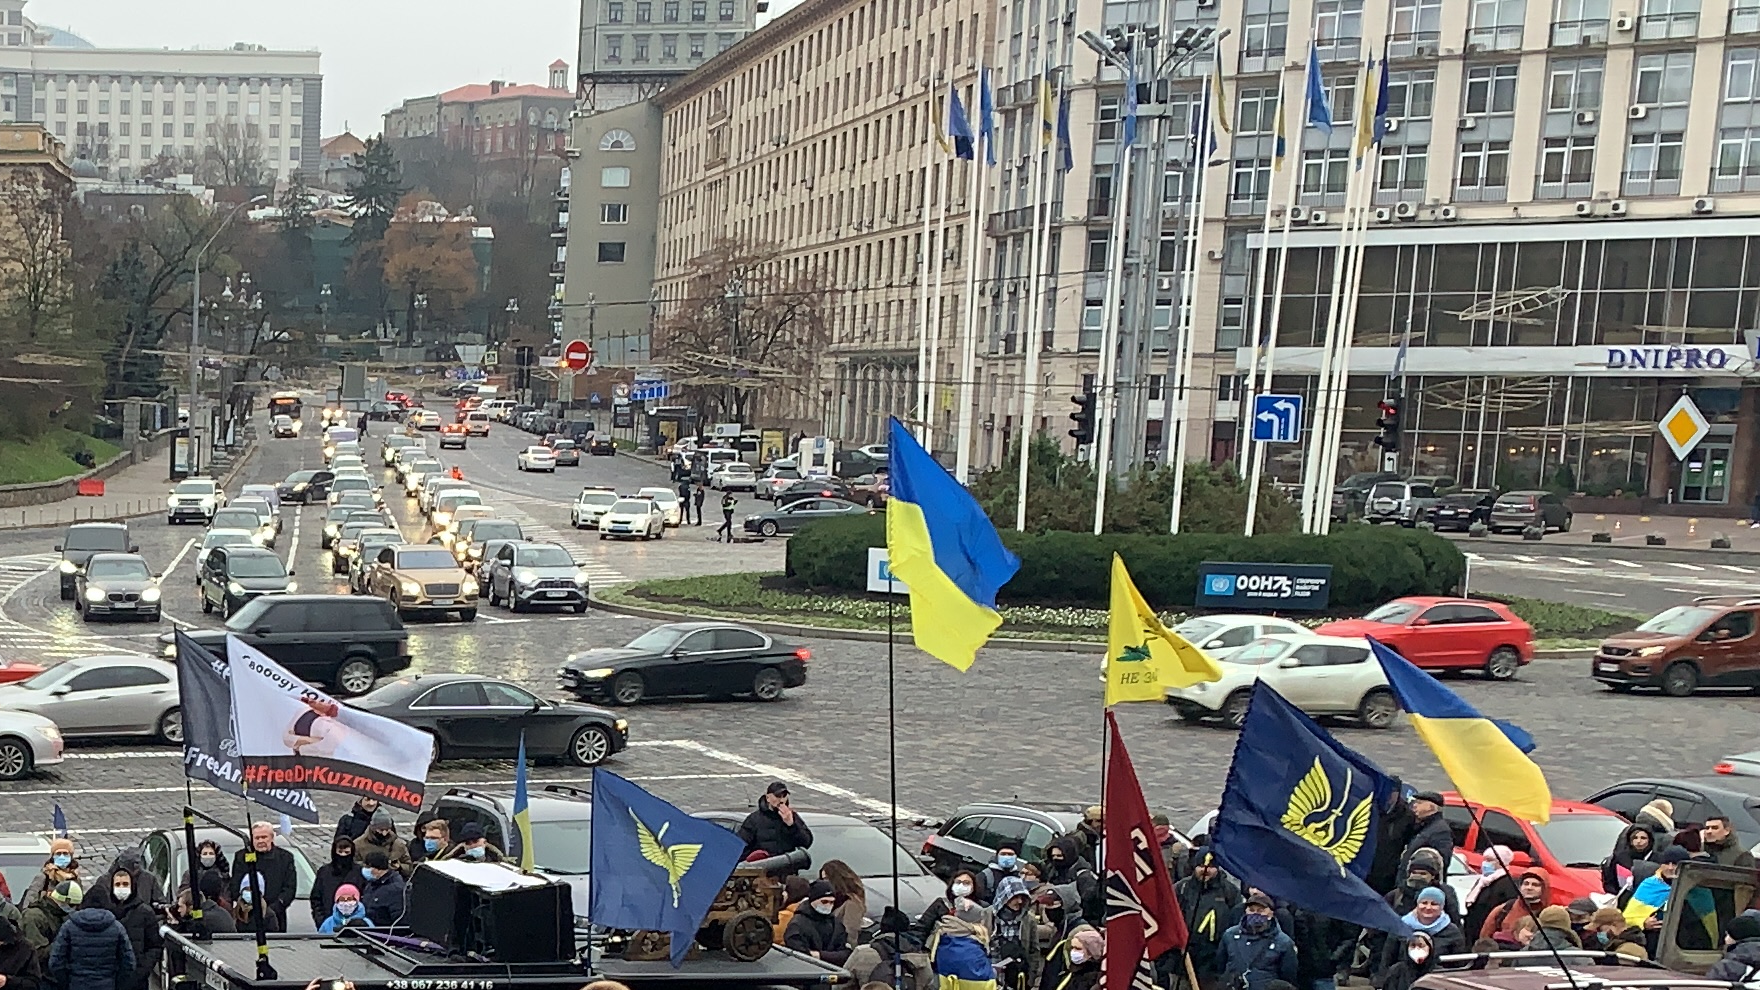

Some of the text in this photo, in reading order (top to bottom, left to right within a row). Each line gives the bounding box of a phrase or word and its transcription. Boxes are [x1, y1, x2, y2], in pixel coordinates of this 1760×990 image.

[1606, 347, 1728, 369] DNIPRO
[244, 763, 422, 808] #FreeDrKuzmenko
[386, 979, 494, 990] +38 067 236 41 16
